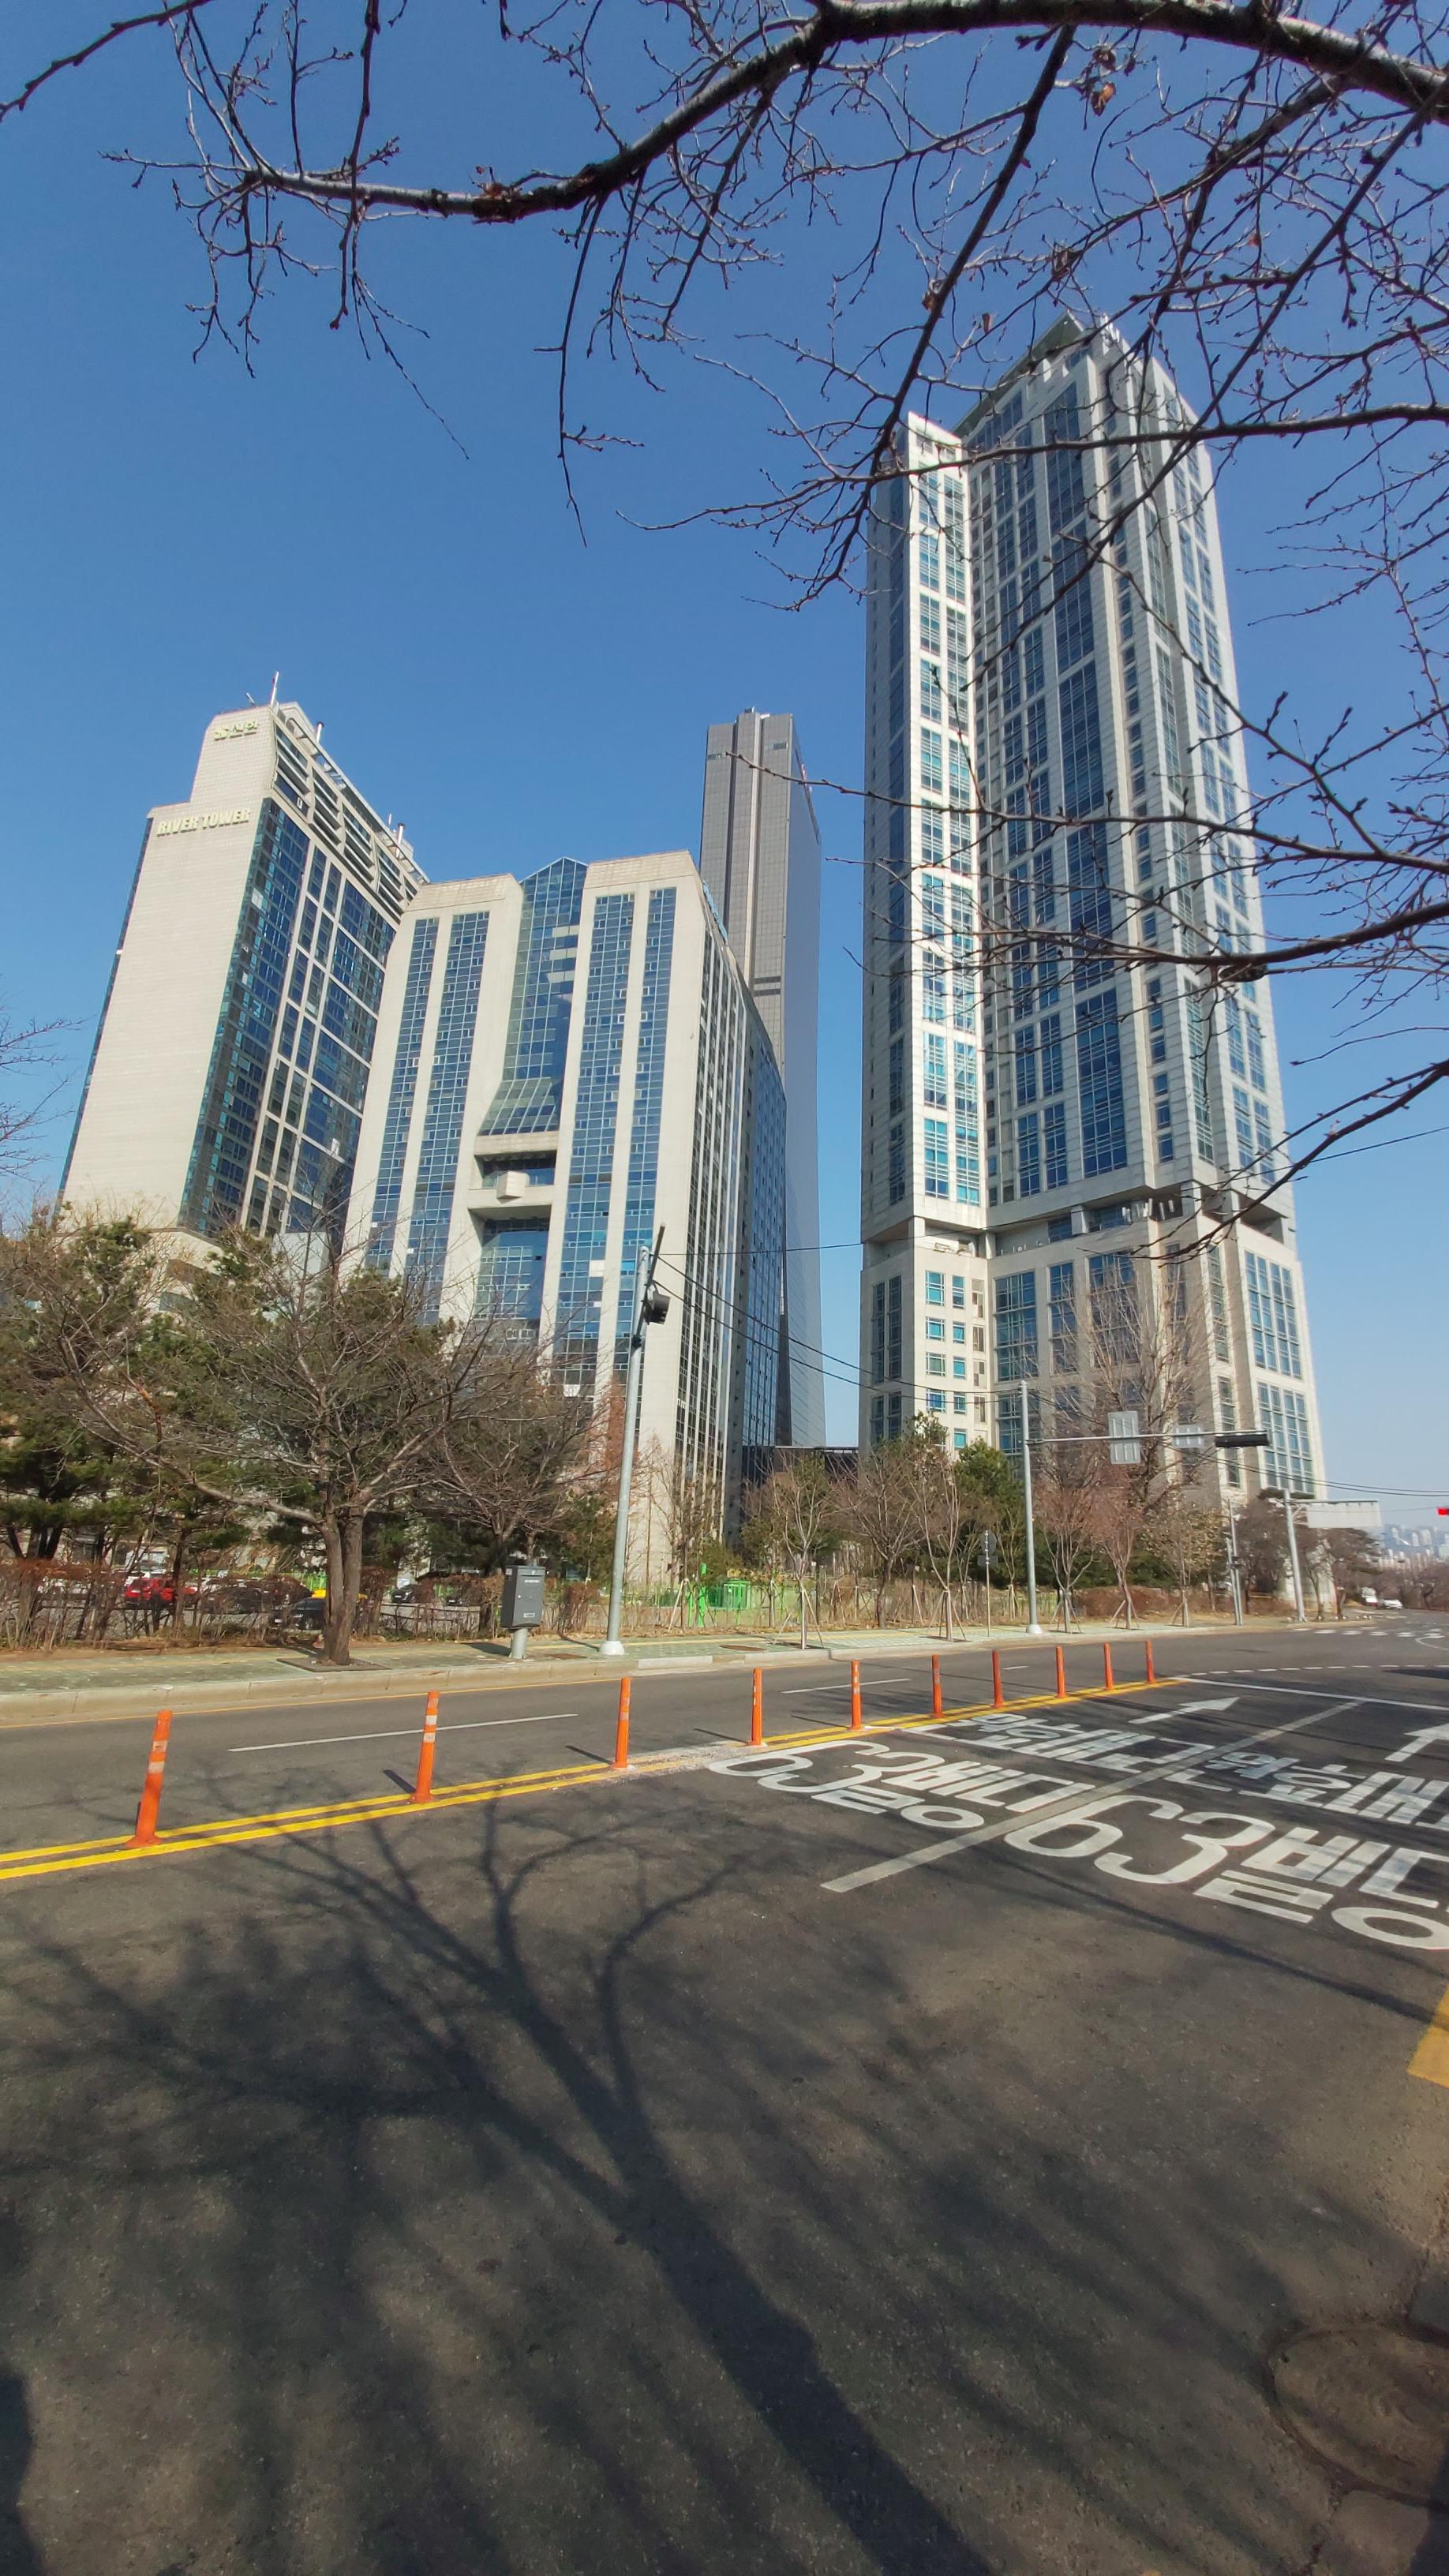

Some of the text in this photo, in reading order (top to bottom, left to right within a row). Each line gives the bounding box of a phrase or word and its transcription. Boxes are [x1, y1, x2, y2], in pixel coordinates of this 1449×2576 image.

[157, 809, 251, 837] RIVER TOWER
[901, 1713, 1215, 1773] 원효대교
[709, 1739, 1097, 1829] 63빌딩
[1163, 1751, 1449, 1832] 원효대
